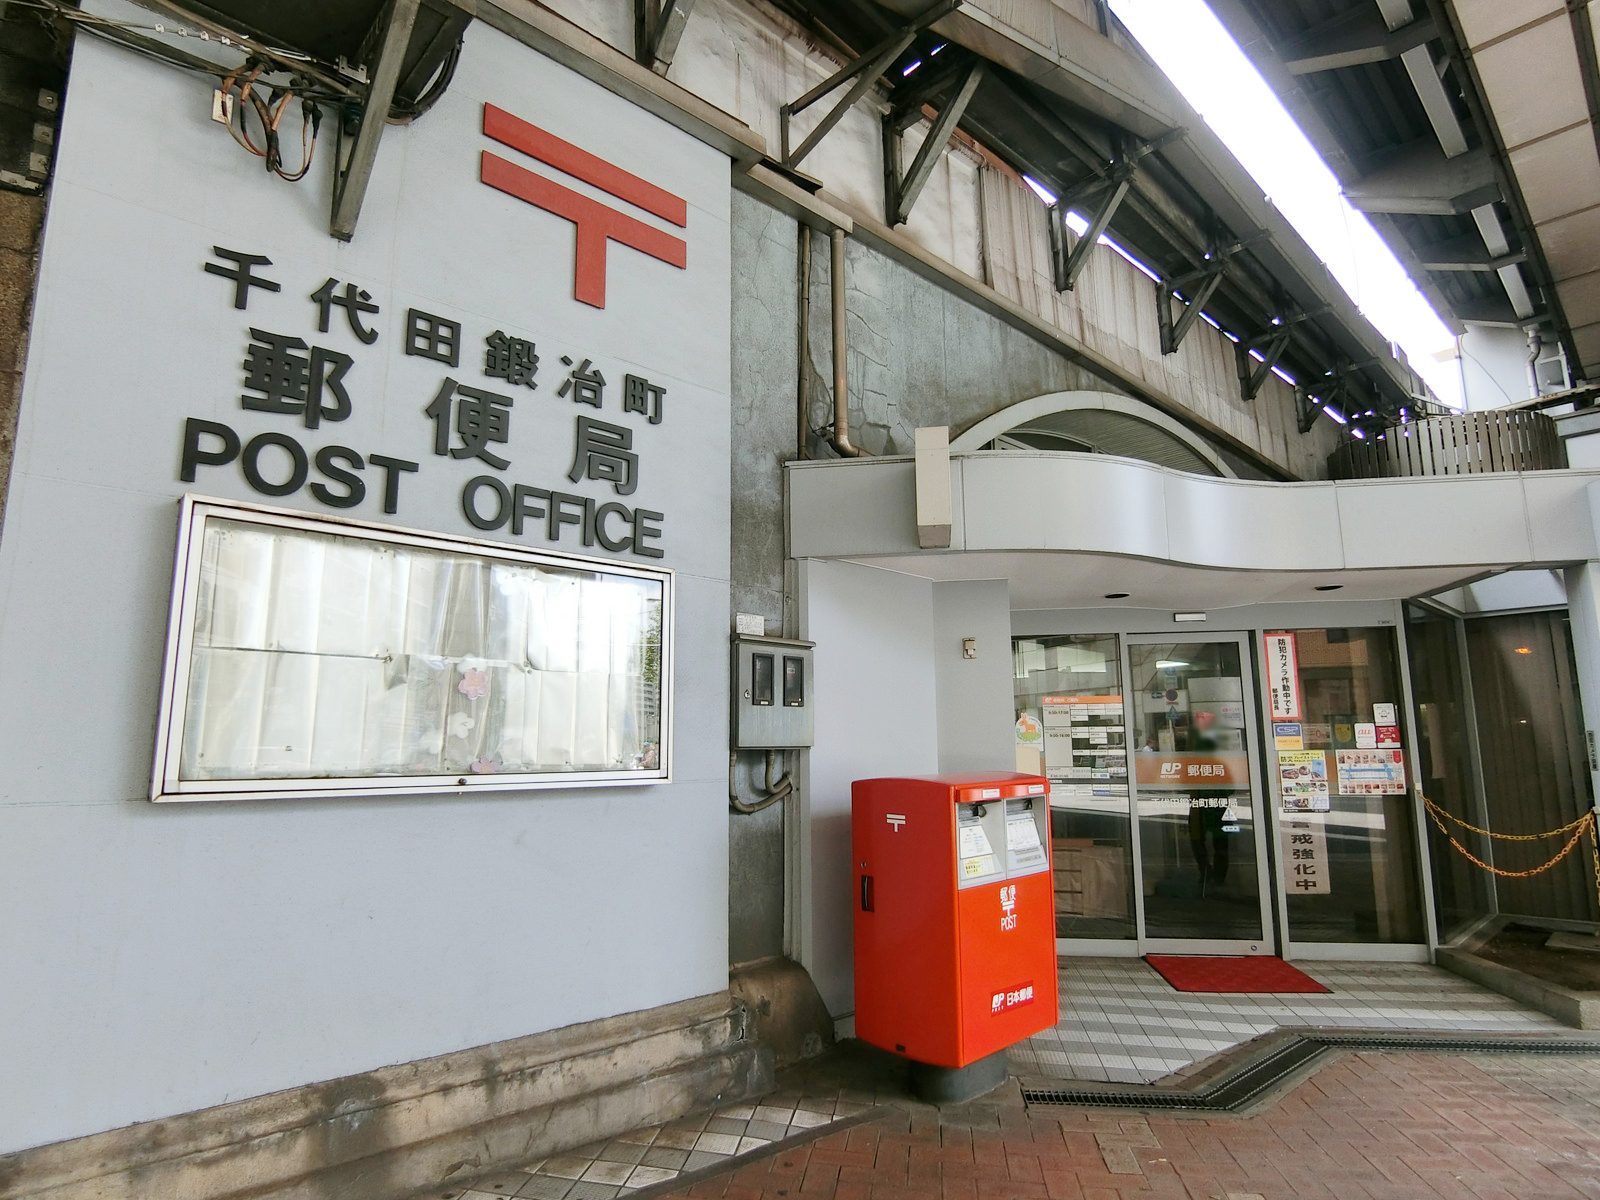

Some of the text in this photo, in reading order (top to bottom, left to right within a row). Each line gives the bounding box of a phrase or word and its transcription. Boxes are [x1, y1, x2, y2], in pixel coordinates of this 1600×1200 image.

[205, 245, 667, 424] 千代田鍛冶町
[241, 327, 640, 495] 郵便局
[180, 417, 664, 558] POST OFFICE
[1277, 638, 1292, 715] 防犯カメラ作動中です
[1276, 726, 1299, 735] CSP
[1187, 764, 1225, 777] 郵便局
[1000, 885, 1016, 903] 郵便
[1001, 914, 1017, 932] POST
[1006, 985, 1033, 1006] 日本郵便
